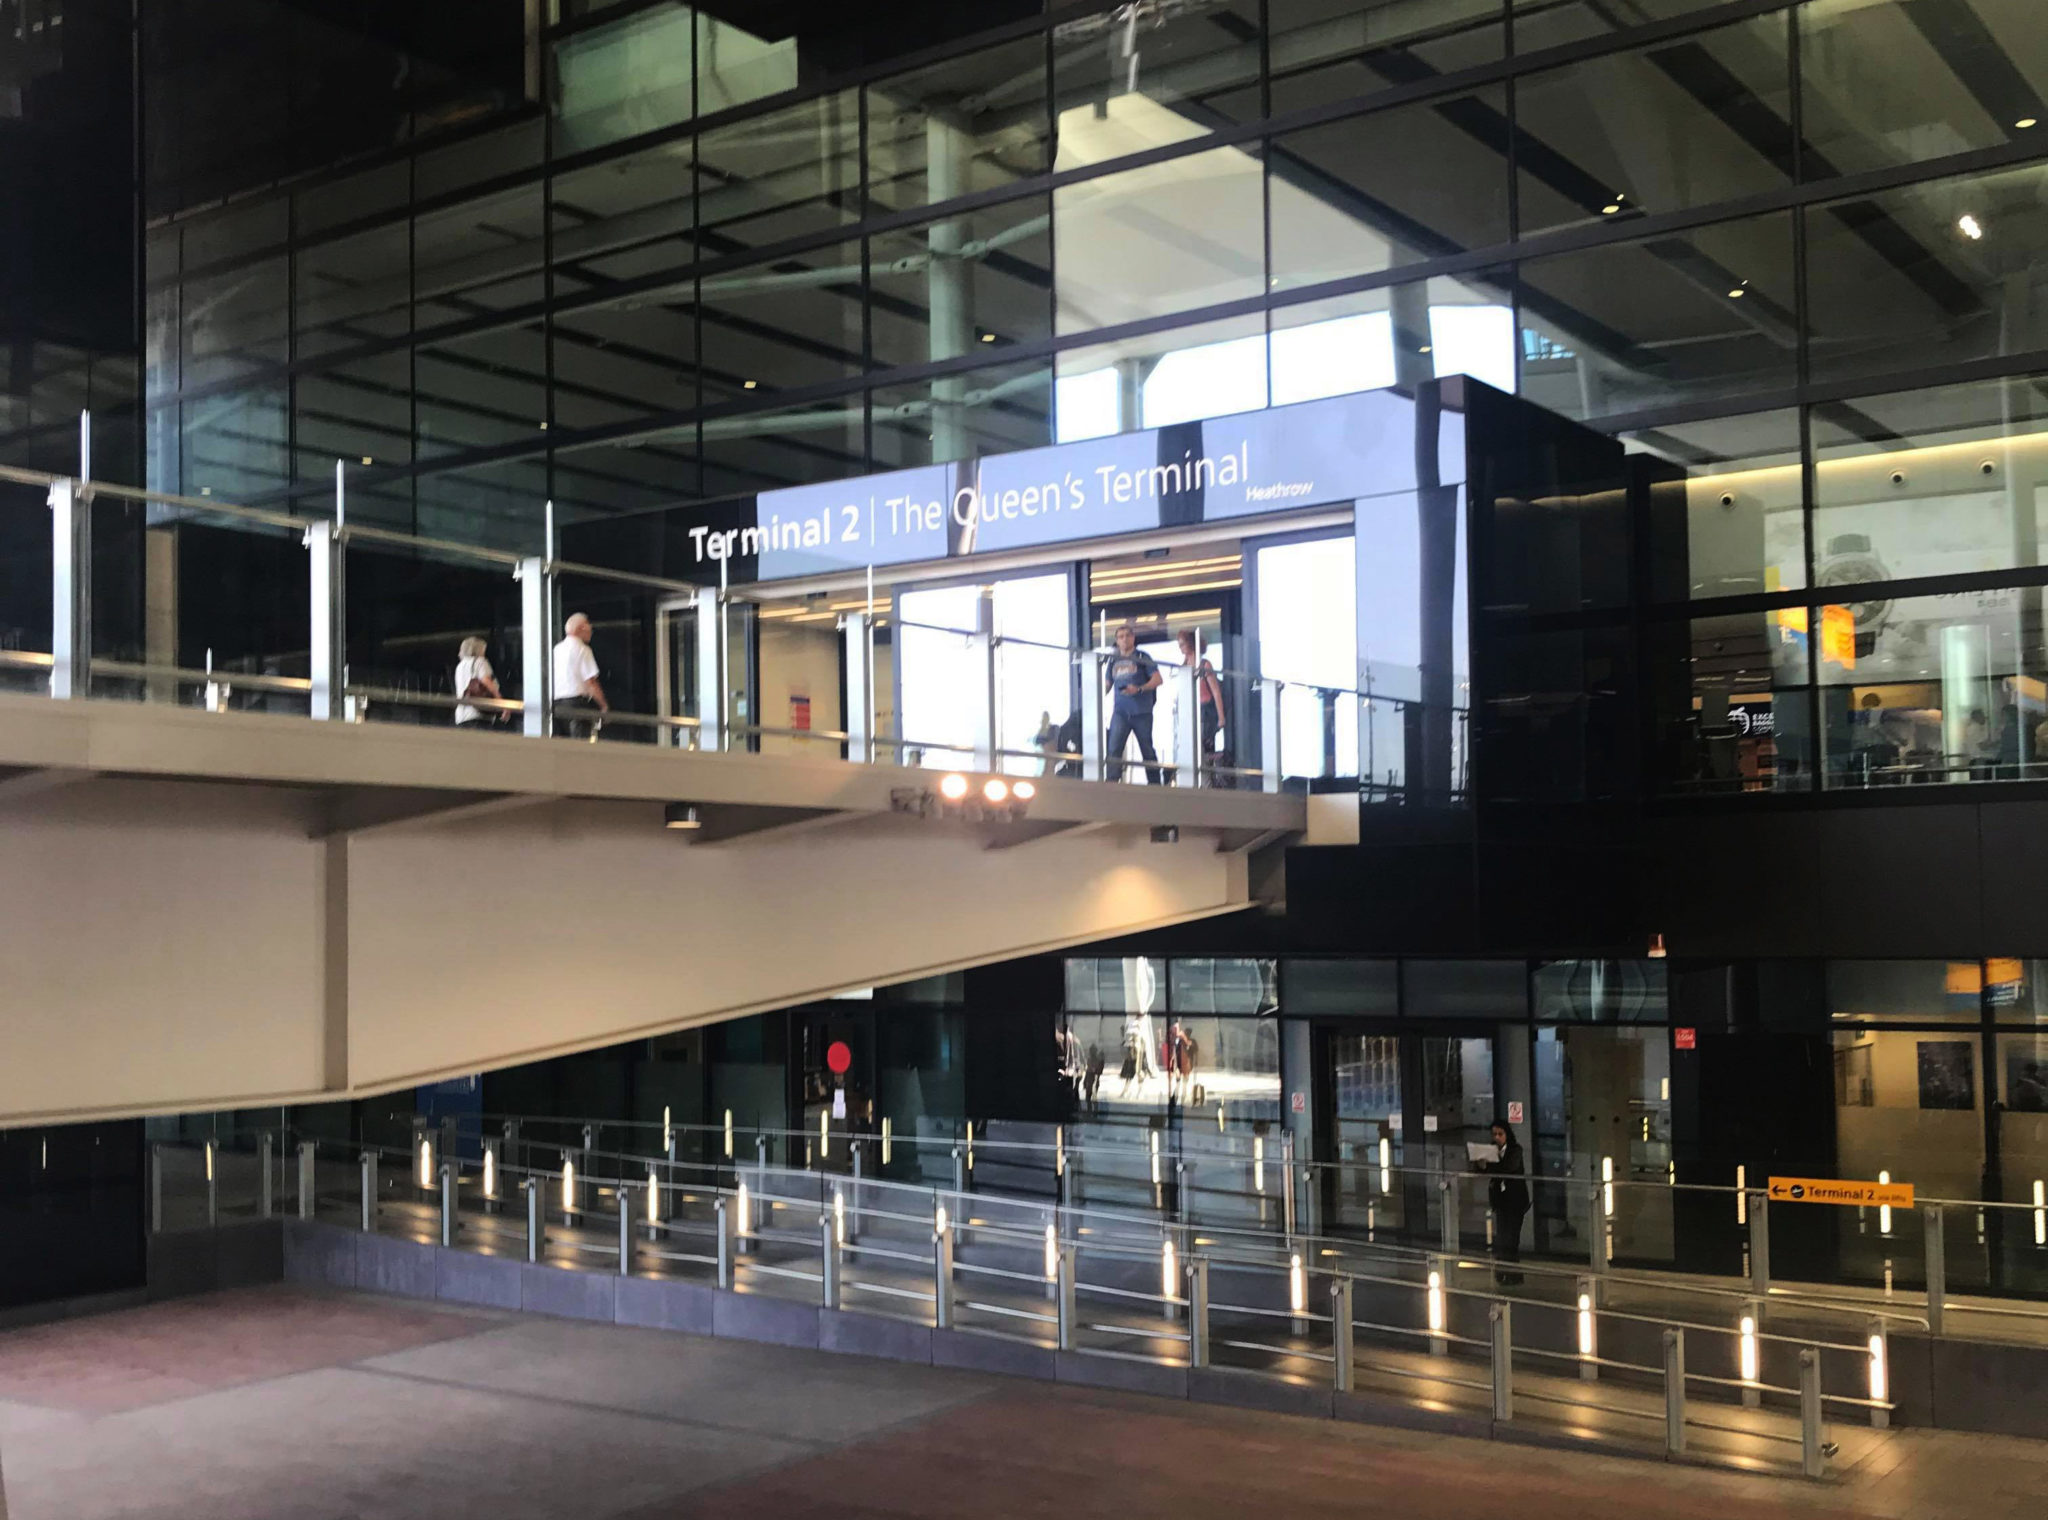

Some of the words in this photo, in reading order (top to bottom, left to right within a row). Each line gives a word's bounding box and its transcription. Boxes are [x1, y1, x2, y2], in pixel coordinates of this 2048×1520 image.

[688, 506, 831, 563] Terminal
[840, 504, 861, 543] 2
[885, 494, 942, 536] The
[953, 471, 1085, 529] Queen's
[1094, 439, 1248, 505] Terminal
[1245, 480, 1314, 502] Heathrow
[1808, 1186, 1864, 1200] Terminal
[1866, 1190, 1875, 1201] 2
